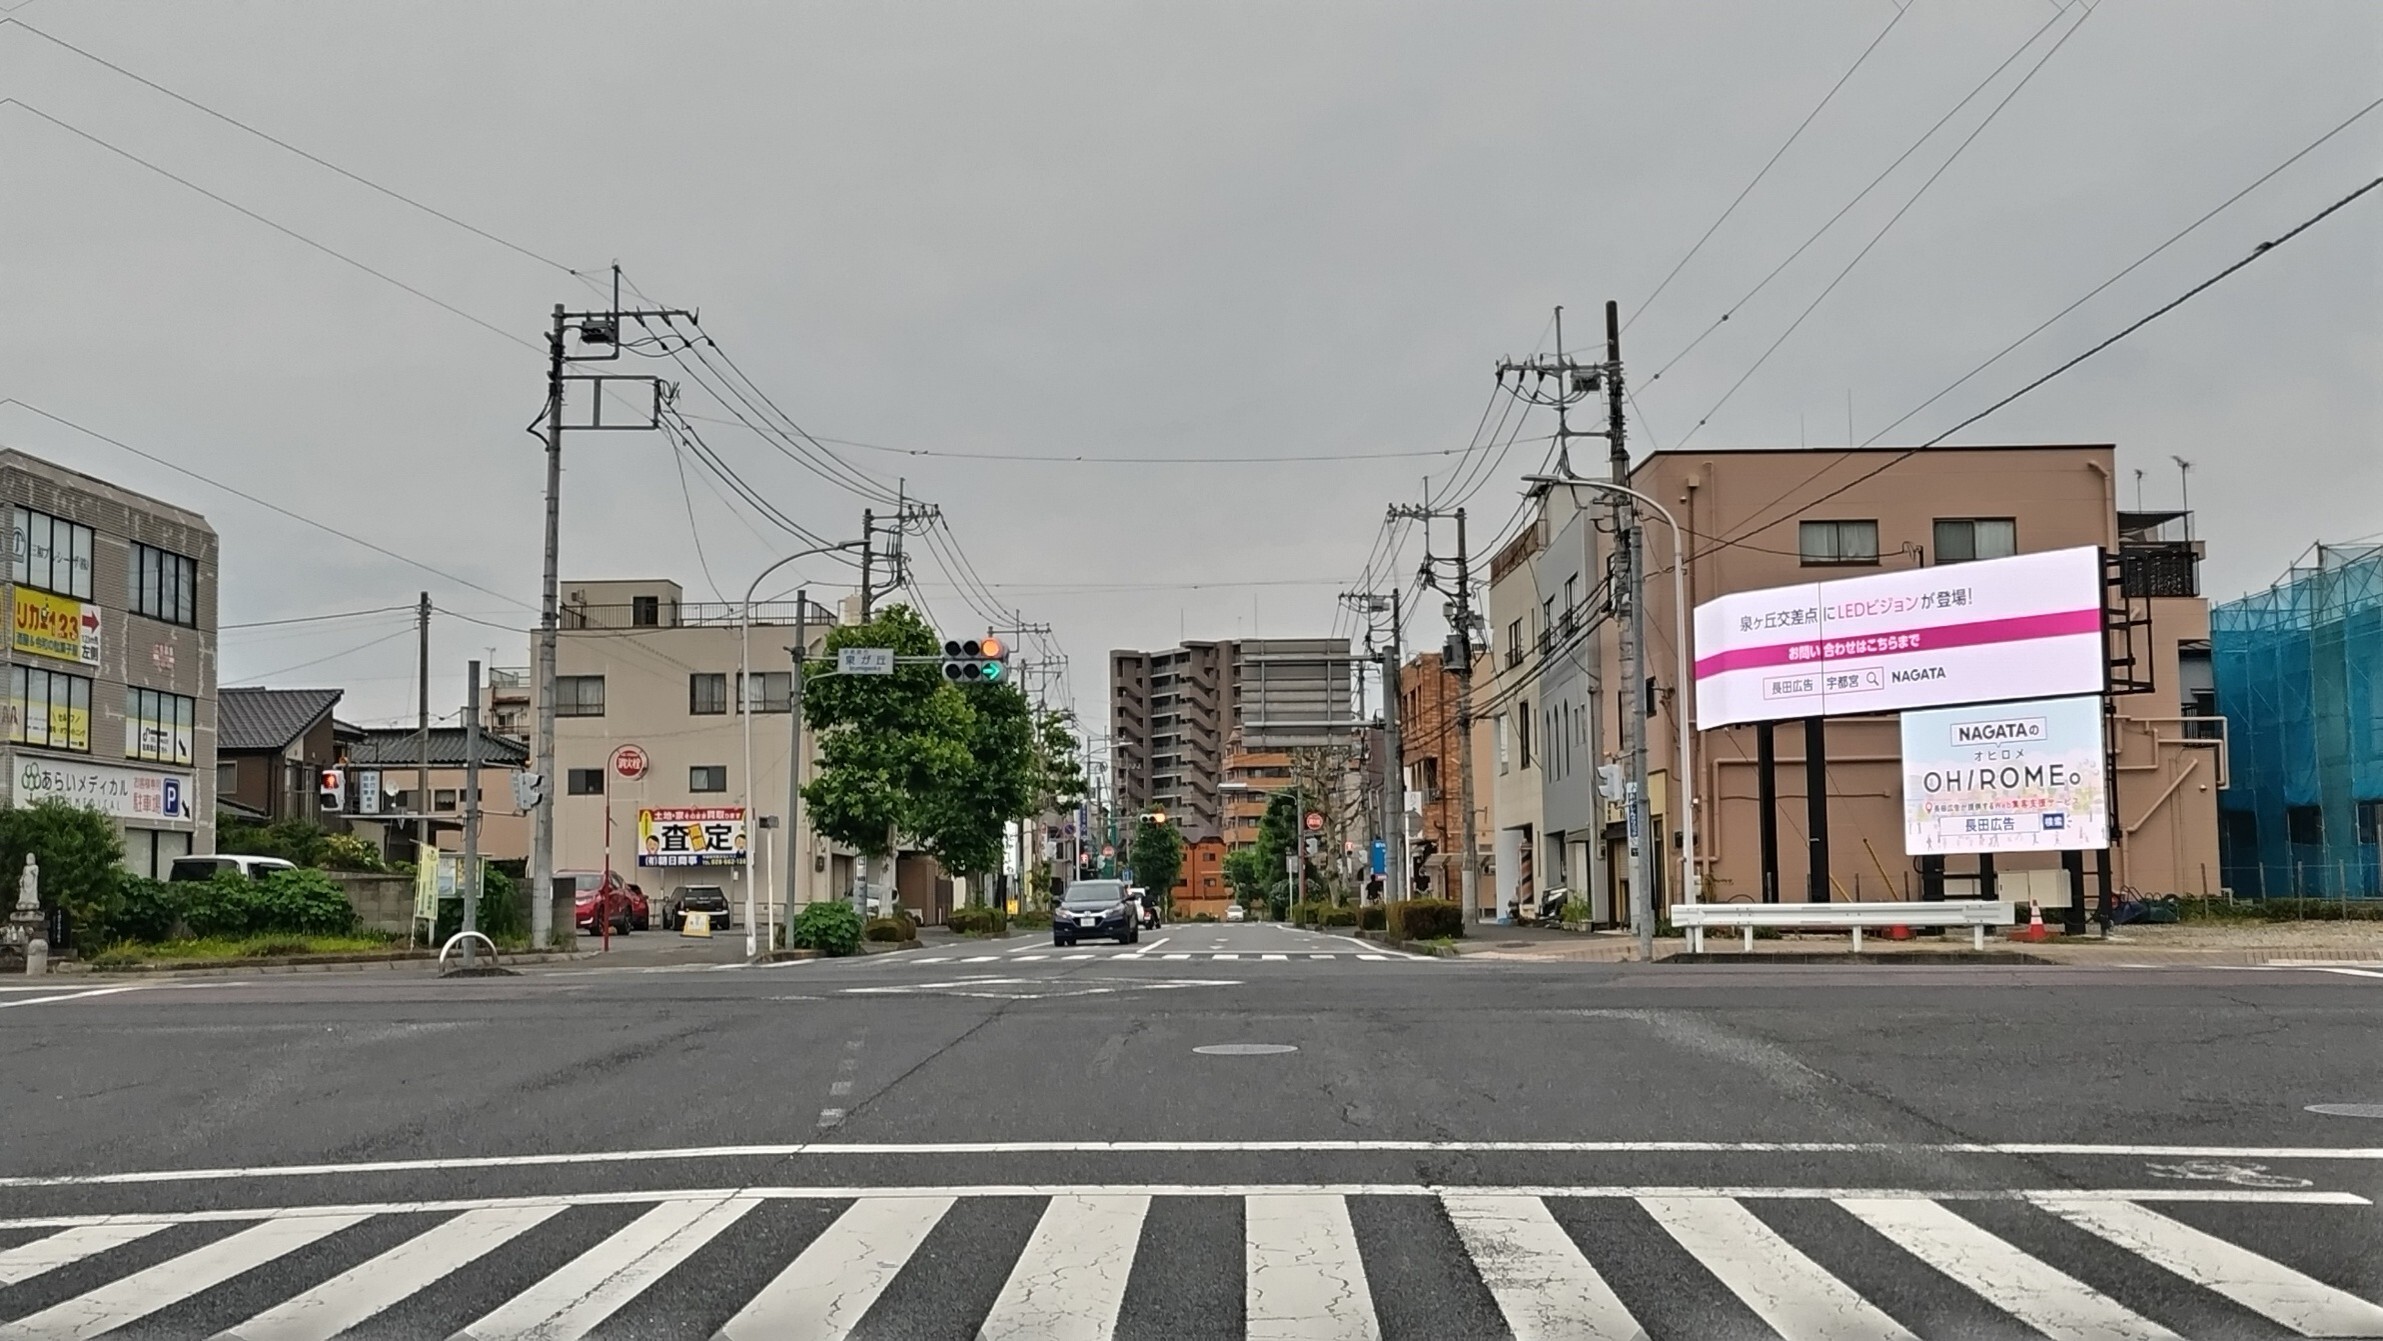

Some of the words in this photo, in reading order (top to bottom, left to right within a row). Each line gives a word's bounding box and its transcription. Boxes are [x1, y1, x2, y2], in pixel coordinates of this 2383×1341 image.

[81, 645, 99, 661] 左側
[1788, 633, 1920, 661] お問い合わせはこちらまで
[1771, 679, 1814, 695] 長田広告
[1826, 674, 1860, 690] 宇都宮
[1892, 667, 1946, 684] NAGATA
[1958, 722, 2040, 742] NAGATAの
[1974, 748, 2025, 762] オヒロメ
[41, 770, 129, 796] あらいメディカル
[133, 791, 162, 815] 駐車場
[1965, 817, 2015, 832] 長田広告
[661, 824, 733, 852] 査定
